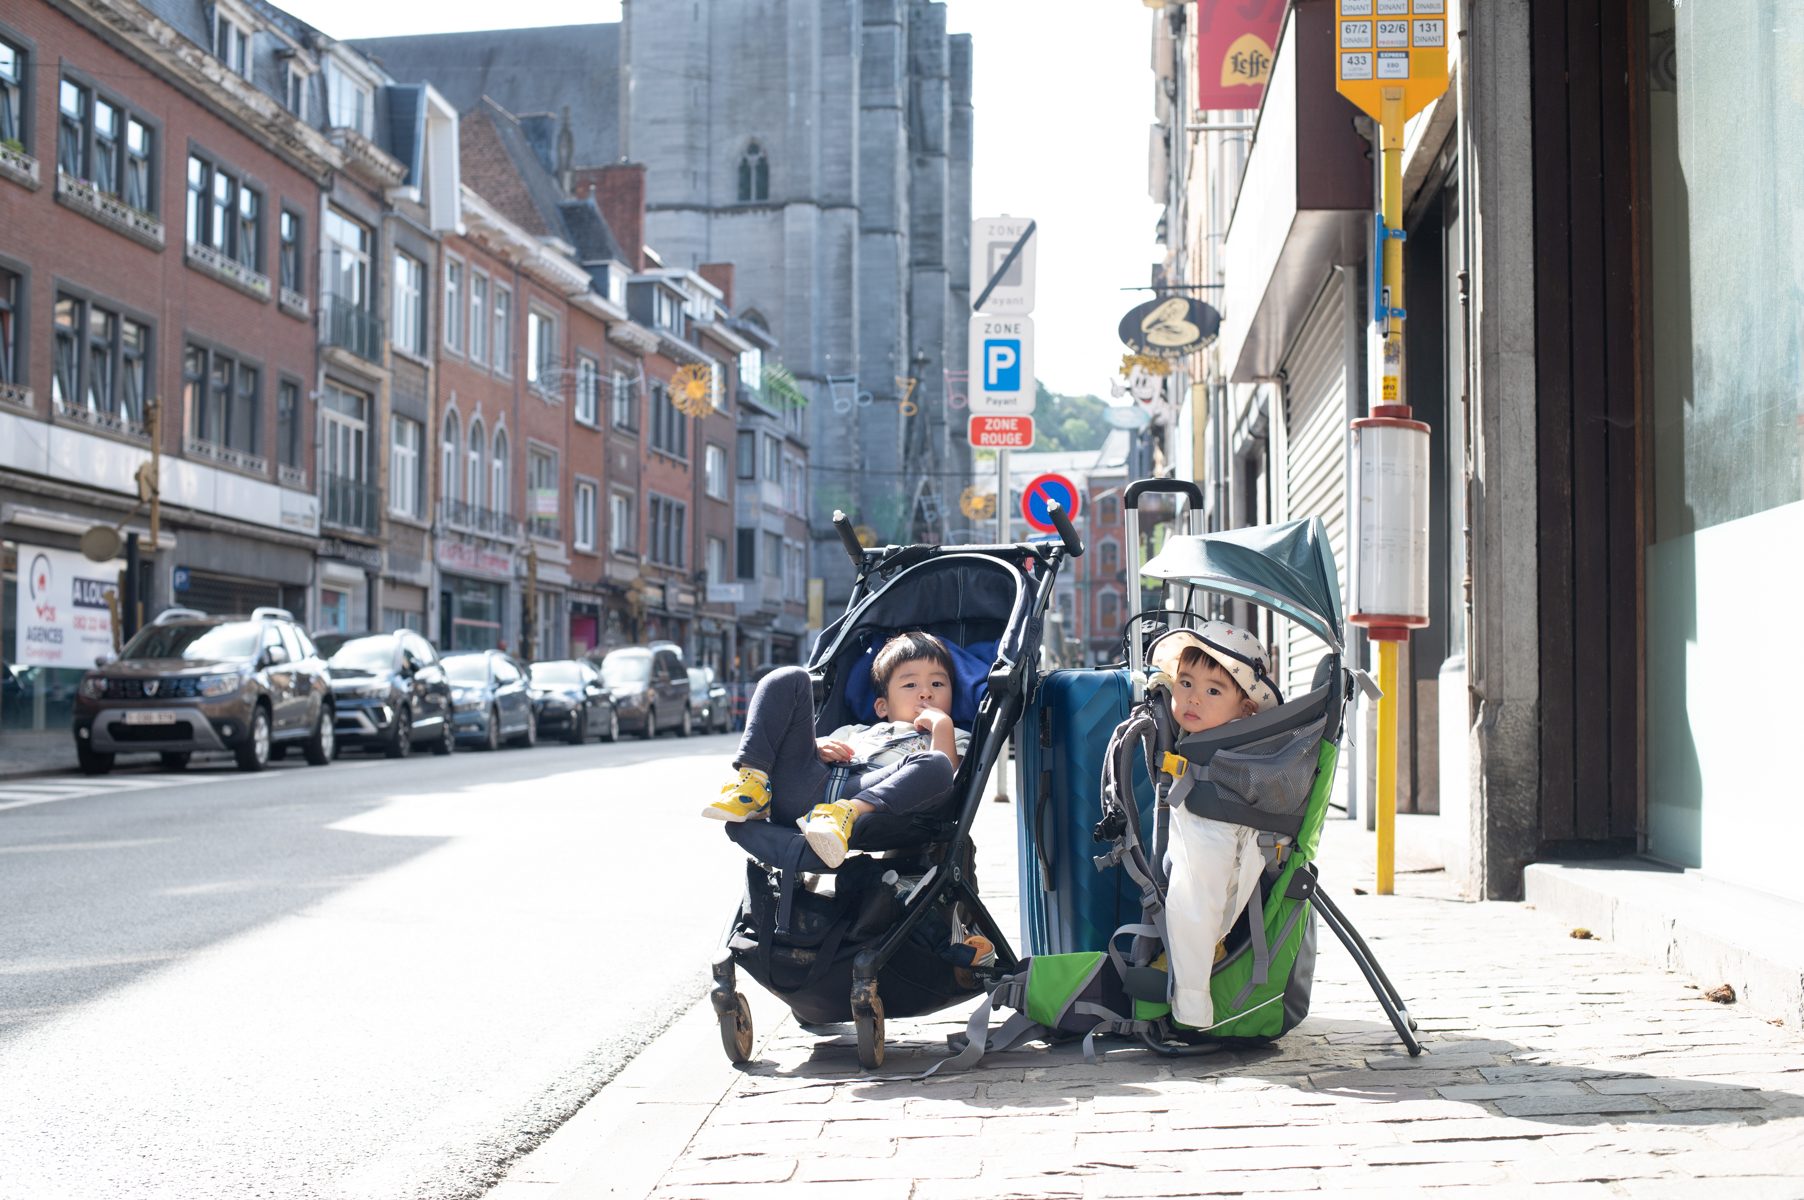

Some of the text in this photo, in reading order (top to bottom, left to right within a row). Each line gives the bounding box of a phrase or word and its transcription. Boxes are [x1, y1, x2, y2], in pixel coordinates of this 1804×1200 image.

[1345, 24, 1368, 34] 67/2
[1380, 23, 1406, 34] 92/6
[1419, 22, 1438, 33] 131
[1414, 35, 1441, 43] DINANT
[1230, 49, 1269, 79] Leffe
[1347, 56, 1367, 66] 433
[988, 225, 1023, 237] ZONE
[984, 323, 1021, 334] ZONE
[988, 346, 1016, 385] P
[986, 397, 1018, 406] Payant
[985, 419, 1018, 430] ZONE
[980, 433, 1022, 445] ROUGE
